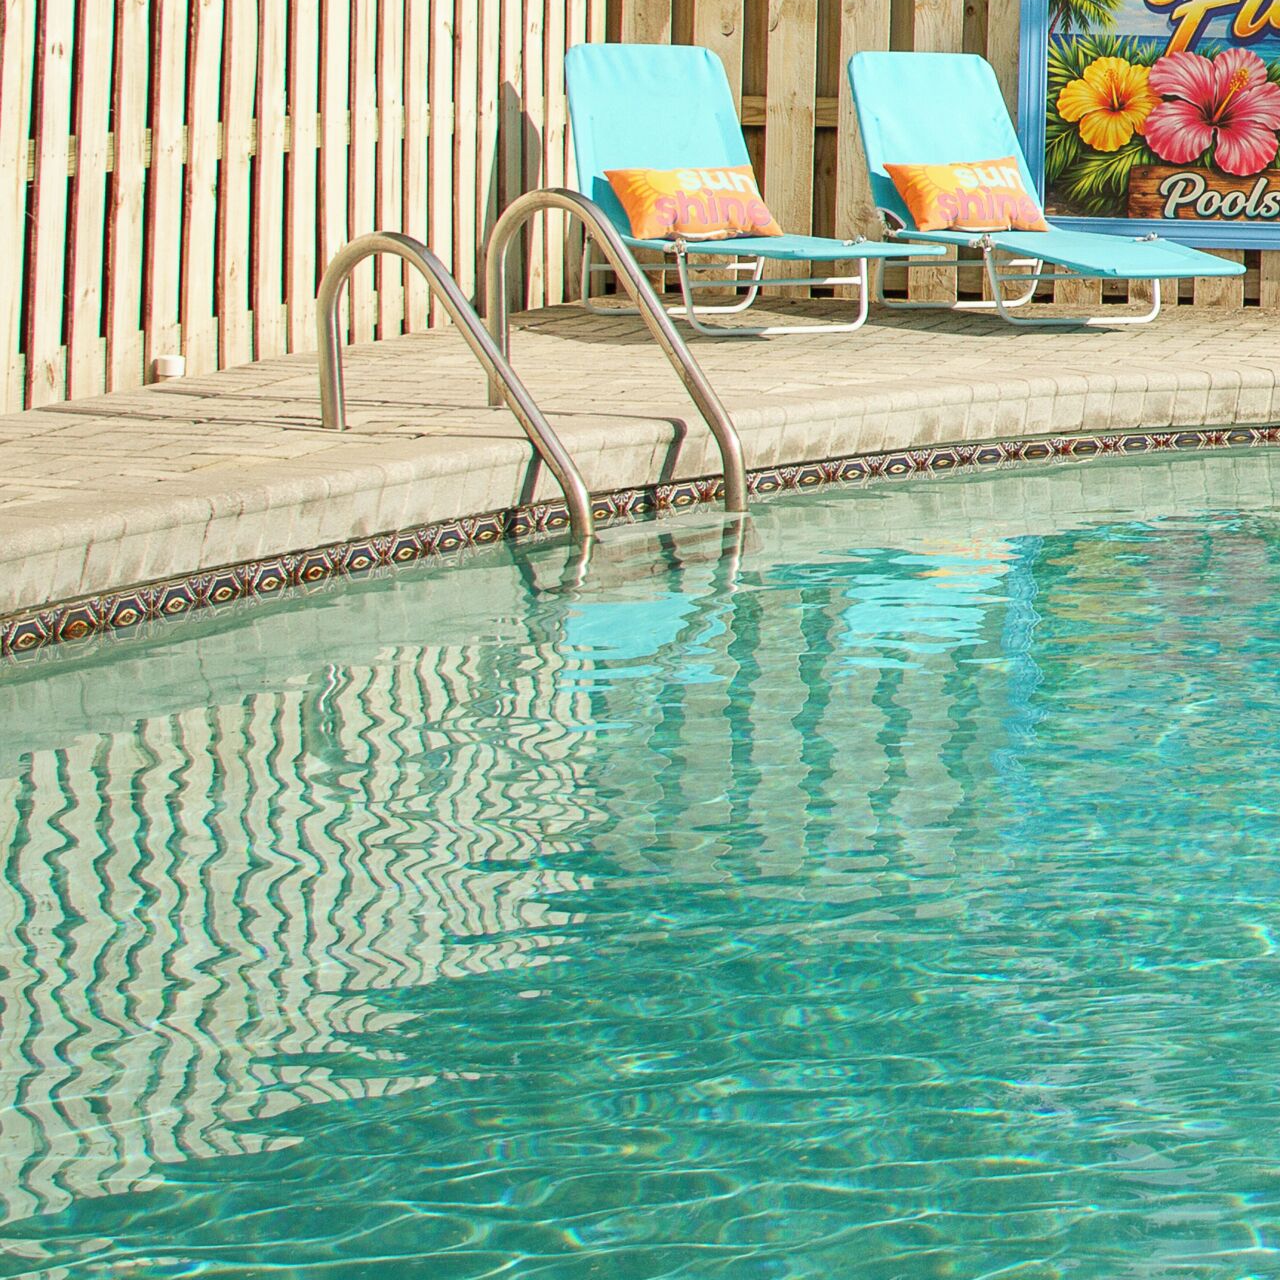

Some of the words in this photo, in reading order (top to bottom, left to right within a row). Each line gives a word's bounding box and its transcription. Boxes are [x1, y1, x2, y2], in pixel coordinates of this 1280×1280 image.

[676, 170, 758, 194] sun
[953, 165, 1026, 192] sun
[655, 190, 772, 227] shine
[937, 186, 1042, 224] shine
